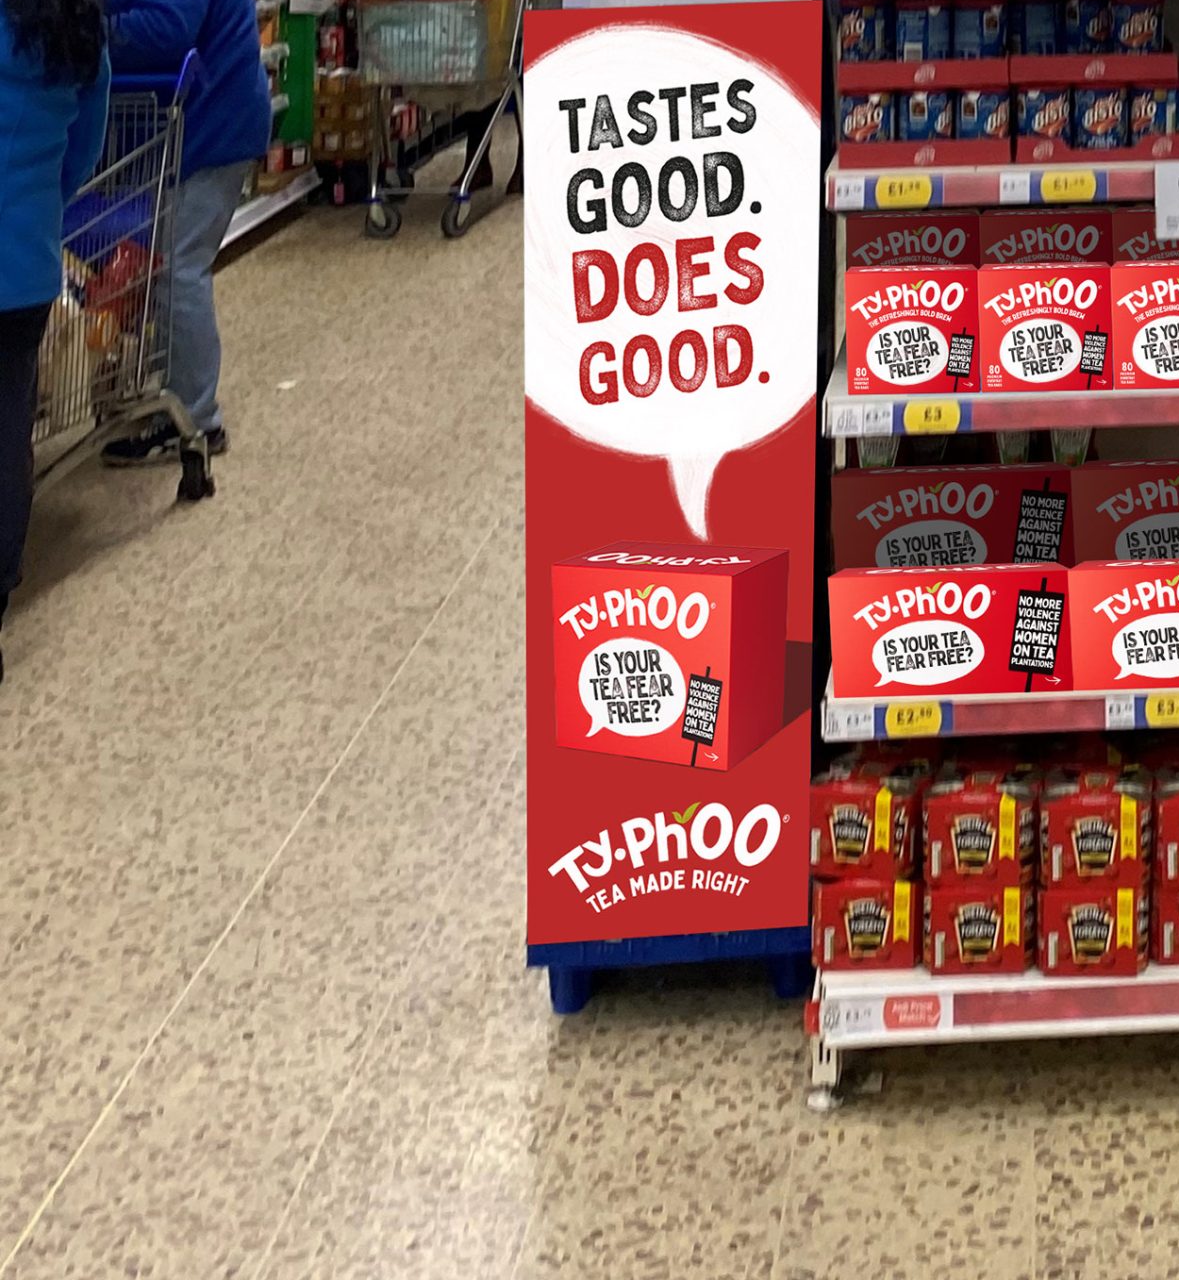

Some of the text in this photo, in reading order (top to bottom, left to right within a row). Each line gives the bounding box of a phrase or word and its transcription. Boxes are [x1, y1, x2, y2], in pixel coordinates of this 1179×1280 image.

[559, 78, 757, 153] TASTES
[566, 151, 762, 234] GOOD.
[572, 231, 765, 324] DOES
[878, 309, 920, 323] REFRESHINGLY
[920, 309, 936, 317] BOLD
[878, 326, 932, 349] IS YOUR
[875, 340, 940, 365] TEA FEAR
[579, 323, 770, 406] GOOD.
[855, 367, 867, 377] 80
[888, 358, 931, 380] FREE?
[1019, 595, 1062, 610] NO MORE
[1018, 608, 1060, 621] VIOLENCE
[1016, 619, 1059, 632] AGAINST
[883, 631, 971, 656] IS YOUR TEA
[1014, 630, 1057, 646] WOMEN
[1123, 632, 1137, 648] IS
[1139, 626, 1179, 646] YOUR
[594, 648, 662, 676] IS YOUR
[886, 647, 974, 673] FEAR FREE?
[1013, 643, 1054, 660] ON TEA
[1126, 646, 1166, 666] FEAR
[1011, 657, 1054, 669] PLANTATIONS
[589, 674, 674, 700] TEA FEAR
[689, 688, 719, 703] VIOLENCE
[690, 679, 720, 694] NO MORE
[607, 699, 661, 725] FREE?
[686, 706, 716, 722] WOMEN
[688, 697, 718, 712] AGAINST
[685, 716, 714, 733] ON TEA
[585, 869, 749, 913] TEA MADE RIGHT
